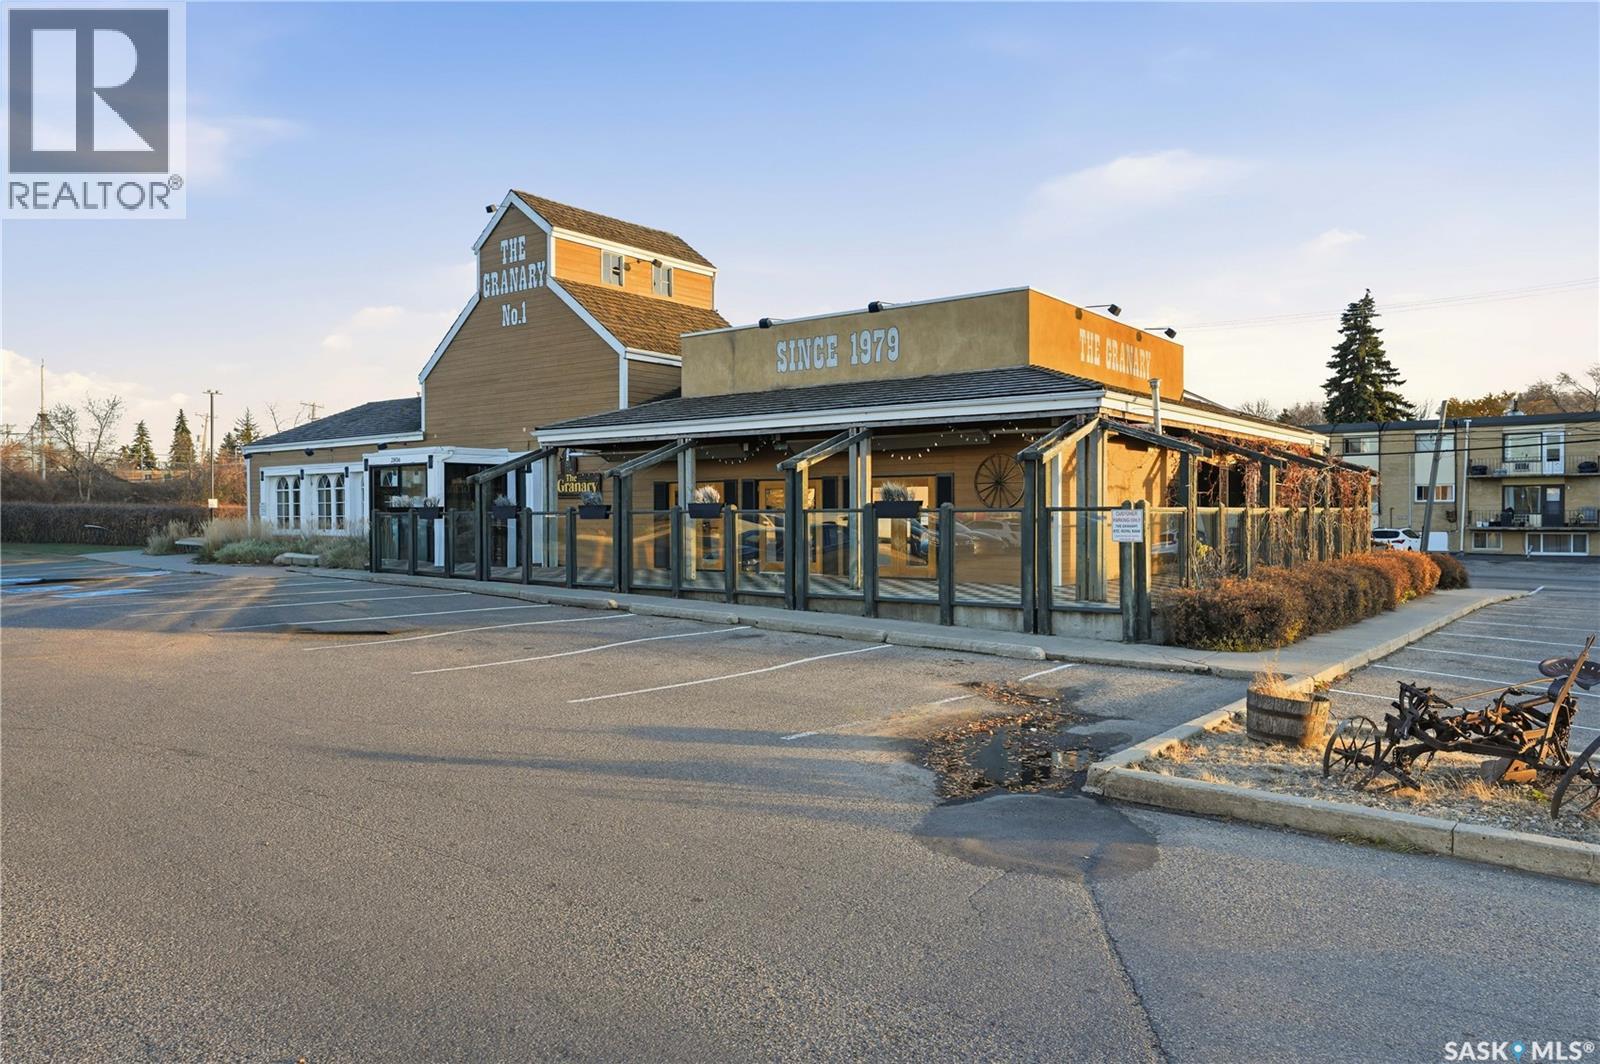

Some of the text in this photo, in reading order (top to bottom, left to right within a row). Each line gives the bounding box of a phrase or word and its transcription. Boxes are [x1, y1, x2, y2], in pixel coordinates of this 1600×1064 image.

[500, 235, 526, 264] THE
[482, 261, 546, 298] GRANARY
[502, 301, 527, 327] No.1
[776, 327, 899, 373] SINCE 1979
[1079, 328, 1151, 379] THE GRANARY
[557, 480, 597, 493] Granary
[566, 474, 577, 482] The
